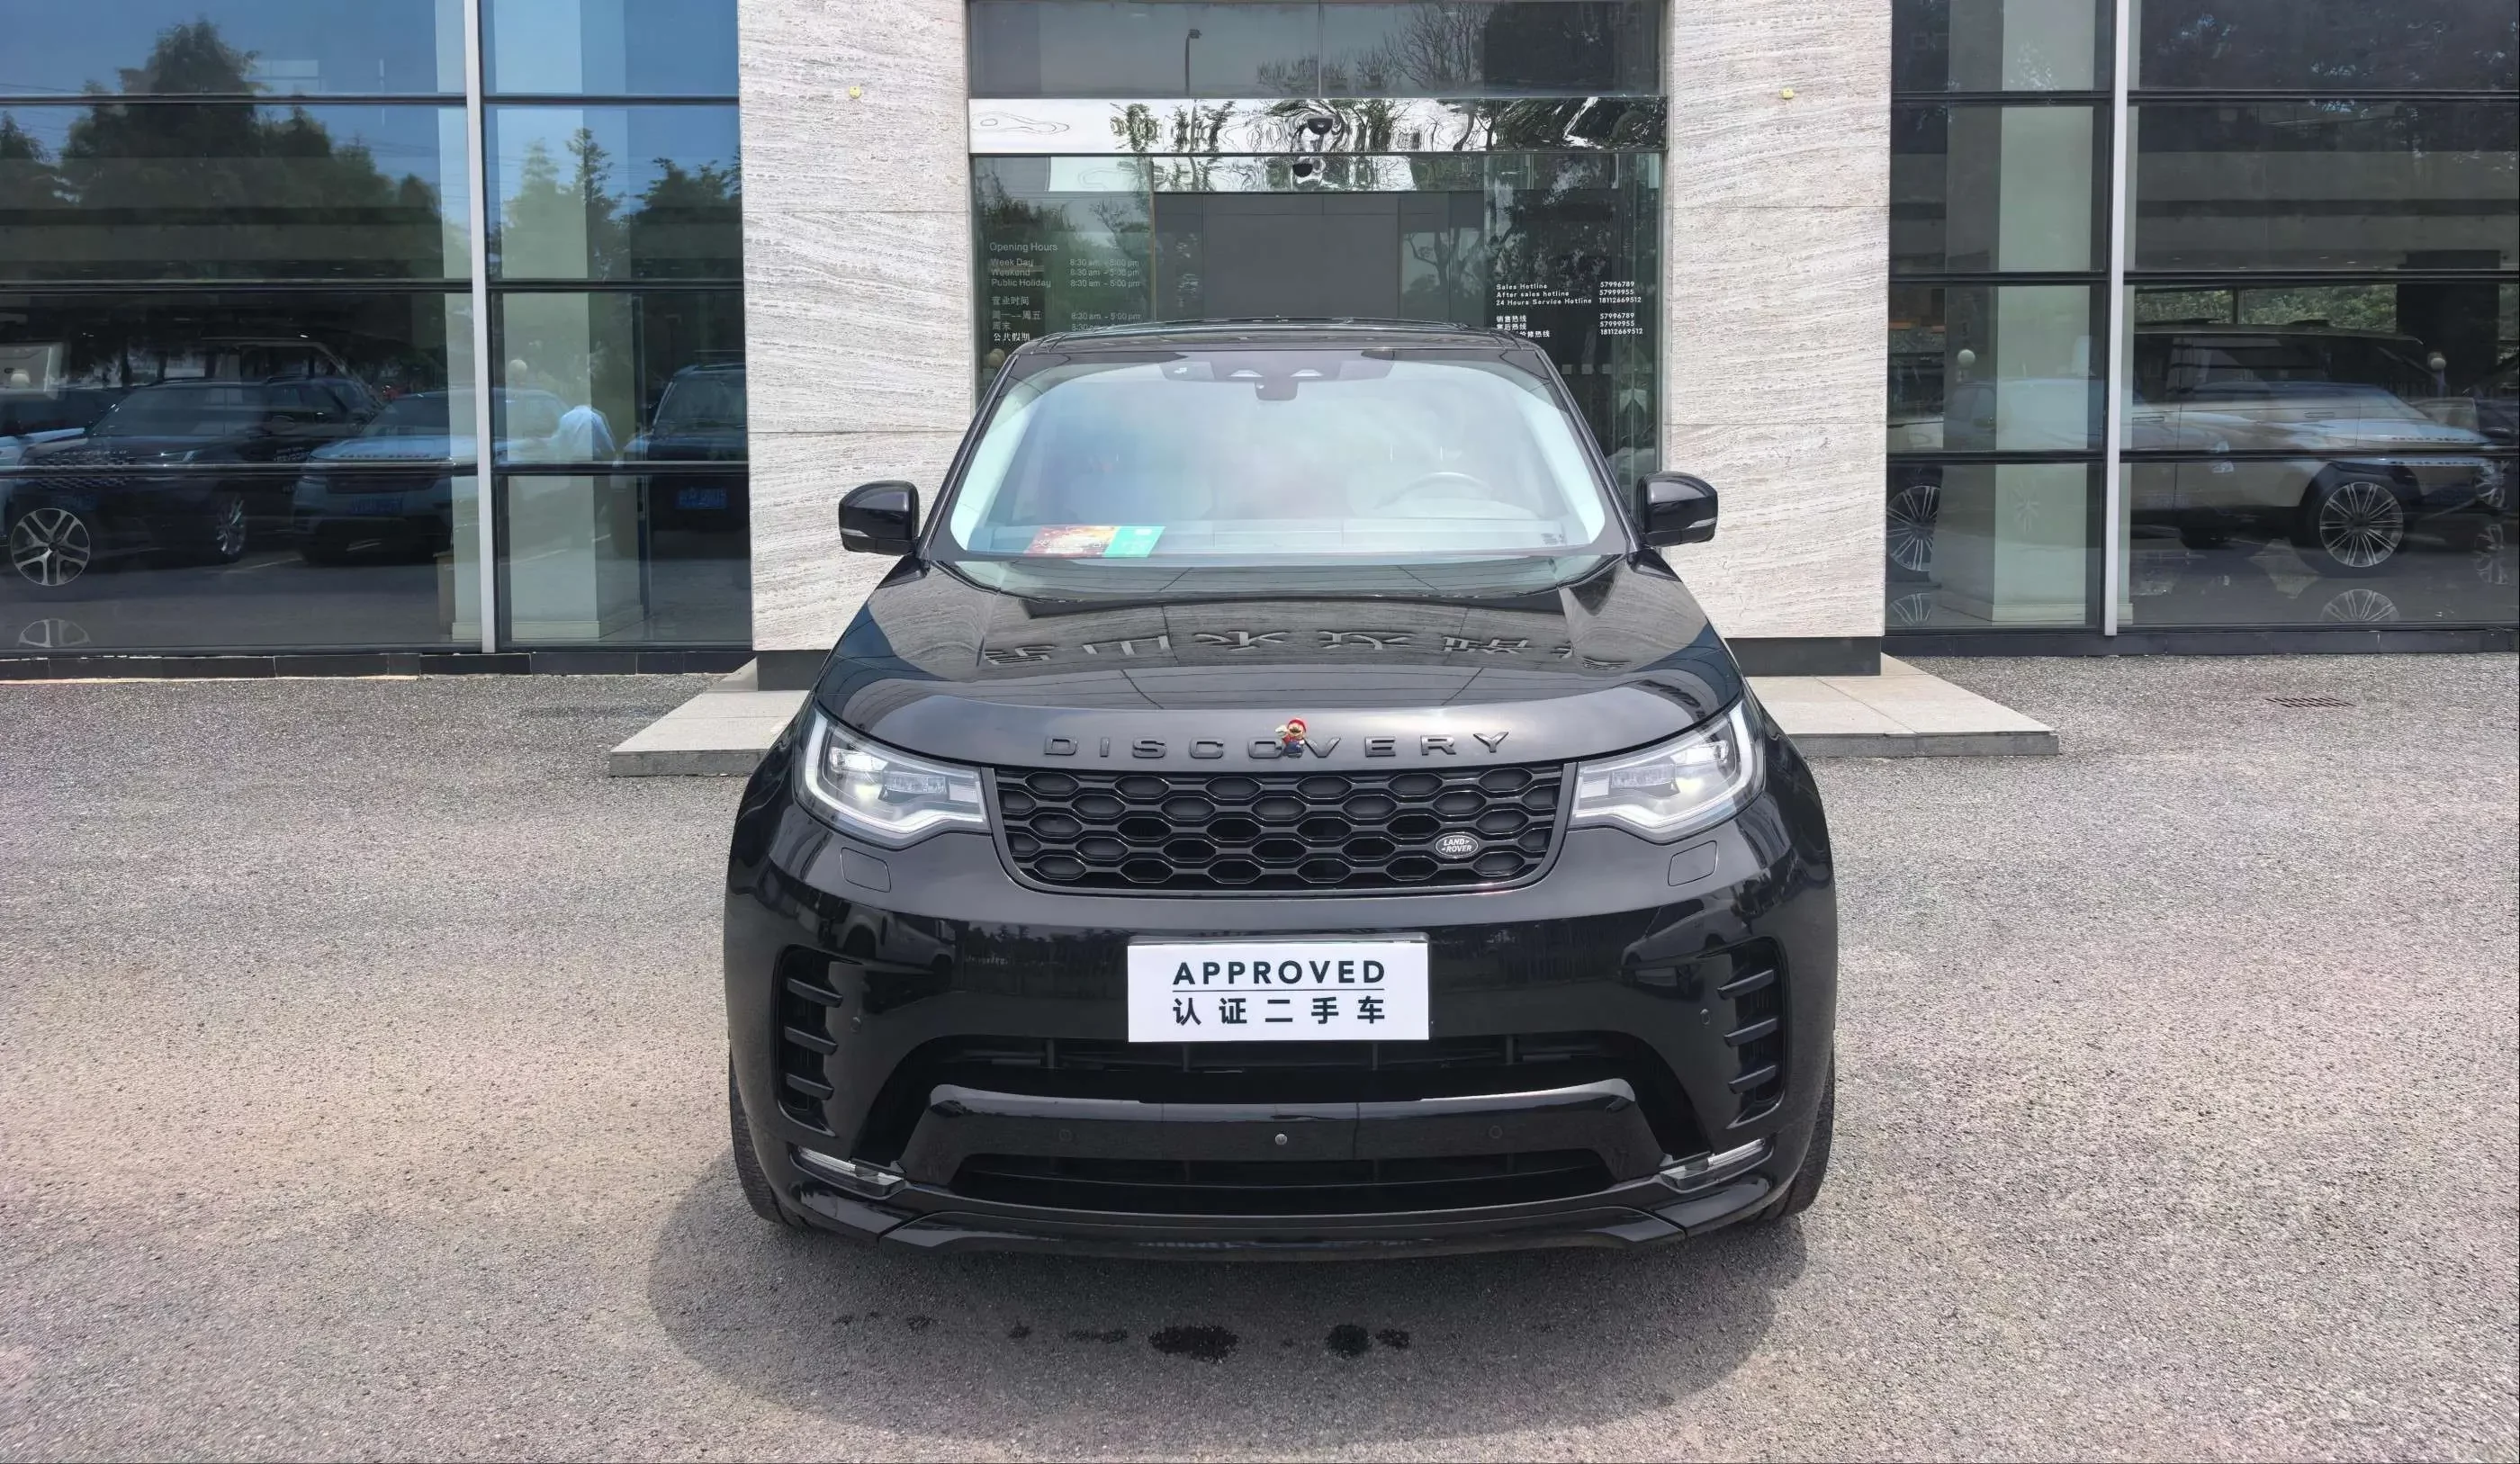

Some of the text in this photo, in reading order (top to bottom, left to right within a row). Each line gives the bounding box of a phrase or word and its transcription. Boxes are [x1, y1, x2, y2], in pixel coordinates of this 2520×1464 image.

[990, 242, 1058, 252] Opening Hours
[991, 257, 1034, 267] Week Day
[991, 268, 1030, 276] Weekend
[992, 278, 1052, 288] Public Holiday
[1070, 279, 1087, 287] 8:30
[992, 295, 1030, 306] 营业时间
[1496, 314, 1527, 323] 销售热线
[1599, 319, 1635, 328] 57999955
[993, 320, 1012, 330] 周末
[994, 332, 1030, 342] 公共假期
[1599, 328, 1643, 336] 18112669512
[1043, 730, 1509, 759] DISCOVERY
[1172, 960, 1386, 985] APPROVED
[1173, 995, 1386, 1026] 认证二手车
